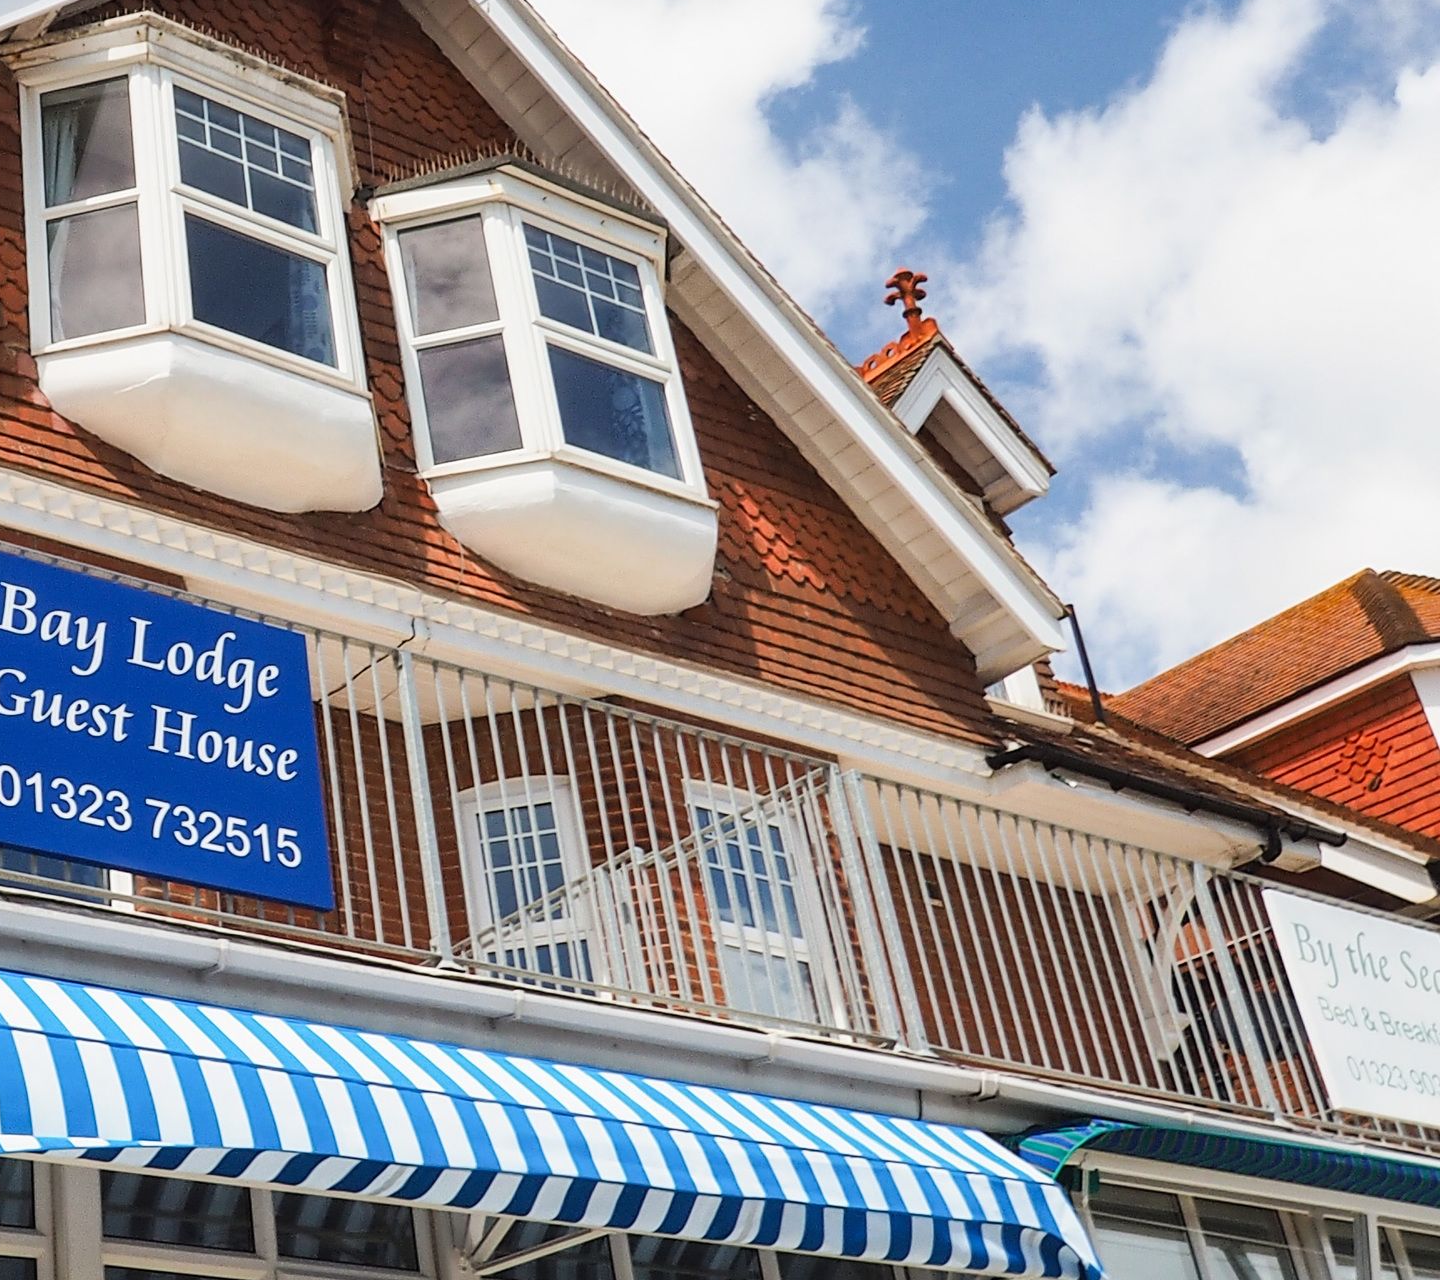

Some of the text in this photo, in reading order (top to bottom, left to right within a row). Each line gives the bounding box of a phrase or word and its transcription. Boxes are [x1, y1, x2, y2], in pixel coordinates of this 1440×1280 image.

[126, 615, 280, 715] Lodge
[147, 703, 299, 782] House
[145, 798, 303, 869] 732515
[1289, 921, 1340, 989] By
[1345, 931, 1392, 983] the
[1317, 996, 1440, 1045] Bed & Breakf
[1346, 1054, 1408, 1091] 01323
